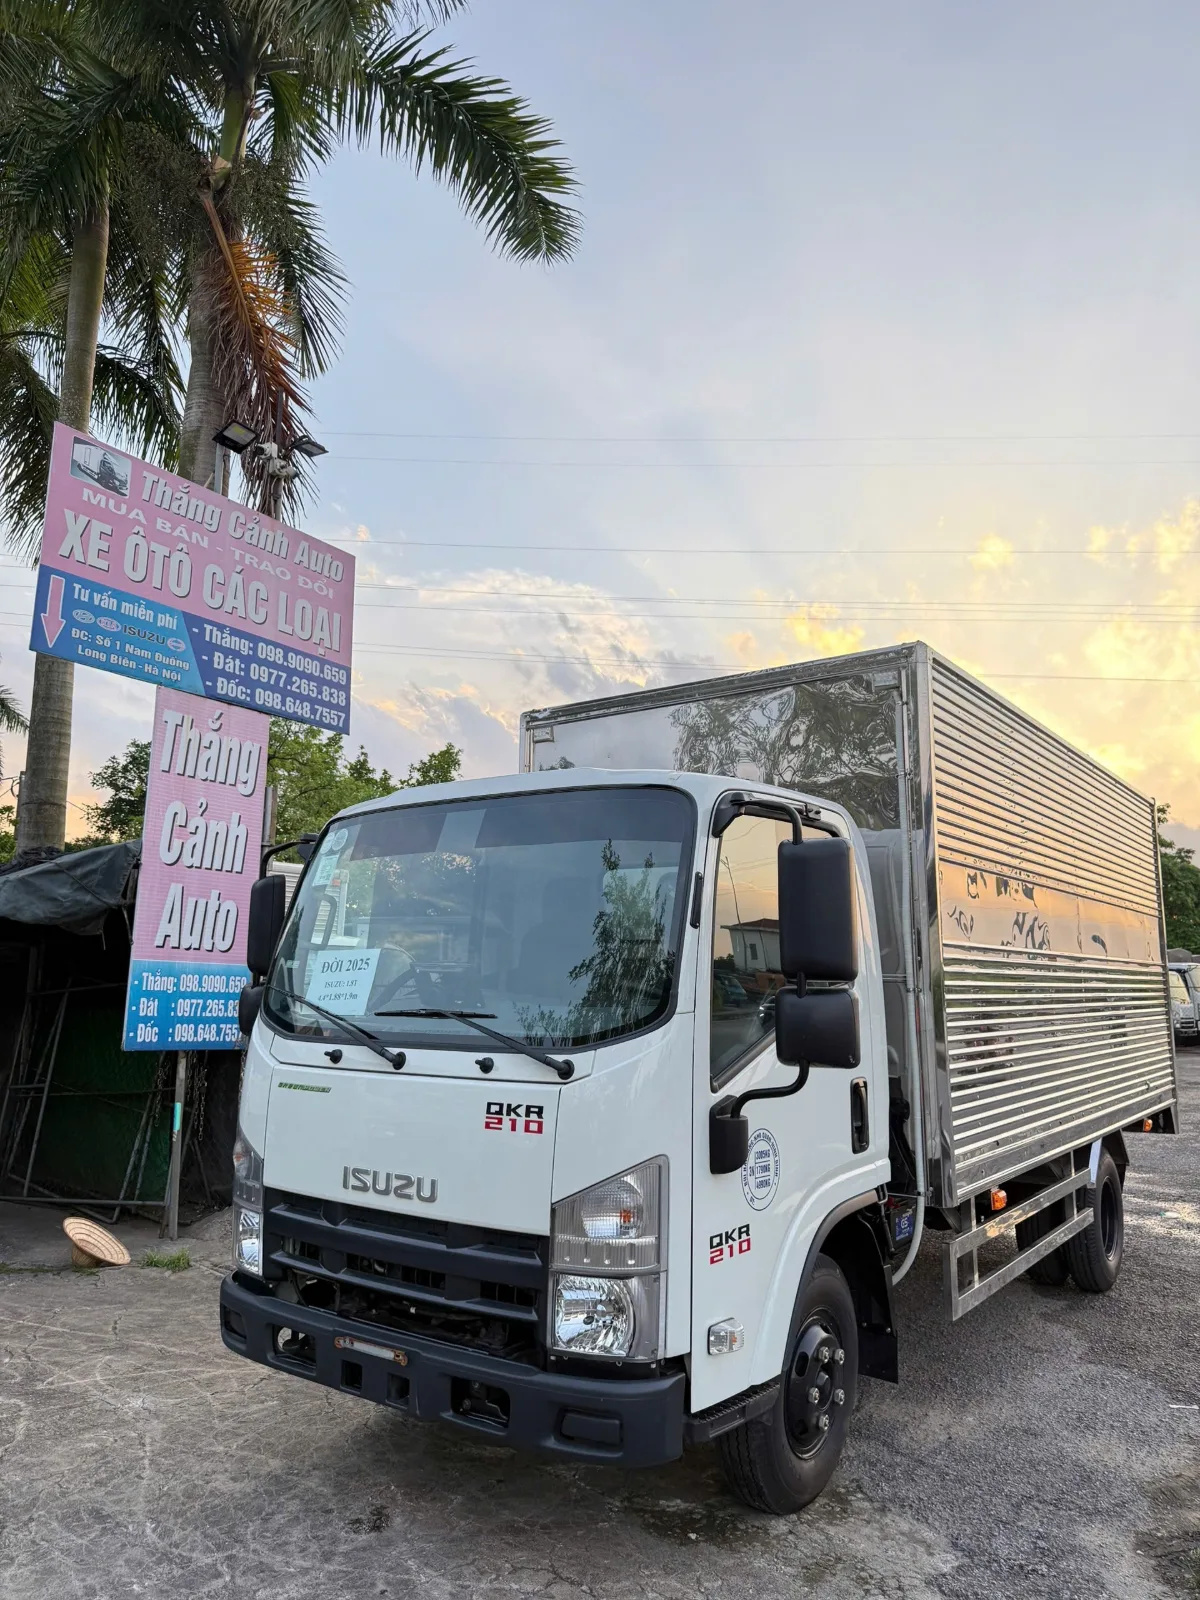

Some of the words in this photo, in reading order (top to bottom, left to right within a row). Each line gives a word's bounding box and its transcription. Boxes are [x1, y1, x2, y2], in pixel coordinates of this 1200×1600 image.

[82, 487, 148, 525] MUA
[156, 516, 209, 549] BÁN
[230, 547, 292, 581] TRAO
[297, 574, 335, 599] ĐỔI
[142, 470, 222, 533] Thắng
[228, 510, 289, 560] Cảnh
[294, 541, 344, 583] Auto
[58, 508, 114, 573] XE
[123, 525, 193, 599] ÔTÔ
[202, 563, 269, 625] CÁC
[277, 590, 342, 657] LOẠI
[73, 582, 91, 603] Tư
[93, 591, 117, 611] vấn
[120, 600, 154, 623] miễn
[157, 613, 178, 630] phí
[71, 628, 93, 642] ĐC:
[95, 635, 113, 648] Số
[115, 641, 121, 650] 1
[125, 643, 152, 660] Nam
[122, 624, 166, 645] ISUZU
[77, 645, 107, 662] Long
[110, 654, 137, 669] Biên
[144, 663, 160, 676] Hà
[162, 671, 182, 683] Nội
[203, 623, 254, 656] Thắng:
[257, 642, 347, 686] 098.9090.659
[216, 676, 251, 702] Đốc:
[255, 688, 346, 729] 098.648.7557
[250, 663, 347, 708] 0977.265.838
[159, 709, 262, 797] Thắng
[158, 797, 249, 875] Cảnh
[154, 881, 239, 953] Auto
[142, 969, 178, 993] Thắng:
[321, 957, 343, 974] ĐỜI
[345, 957, 371, 972] 2025
[139, 998, 158, 1017] Đát
[177, 999, 240, 1017] 0977.265.83
[137, 1020, 158, 1042] Đốc
[484, 1116, 544, 1134] 210
[485, 1102, 544, 1119] QKR
[342, 1165, 438, 1203] ISUZU
[709, 1223, 750, 1250] QKR
[709, 1237, 751, 1265] 210
